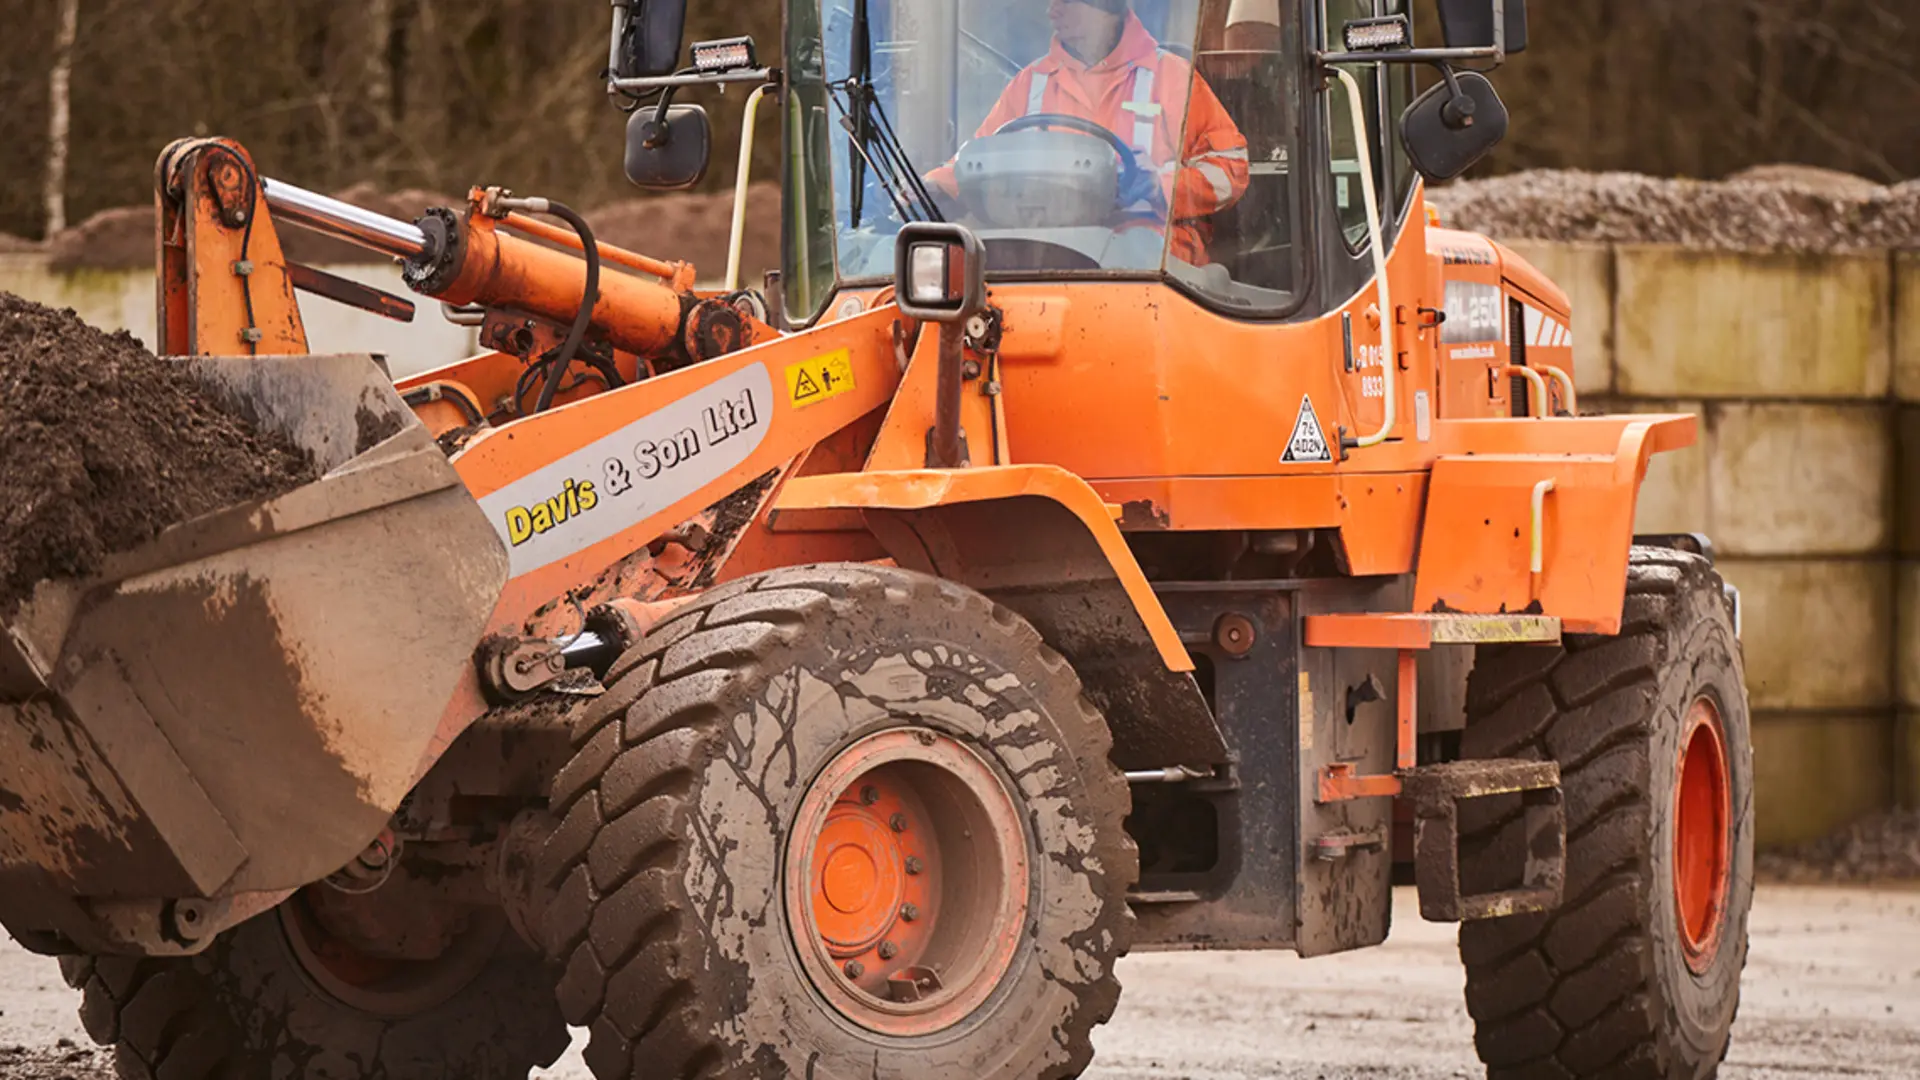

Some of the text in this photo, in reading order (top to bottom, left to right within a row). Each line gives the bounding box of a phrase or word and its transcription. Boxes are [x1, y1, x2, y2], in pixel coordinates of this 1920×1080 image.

[505, 387, 758, 546] Davis & Son Ltd
